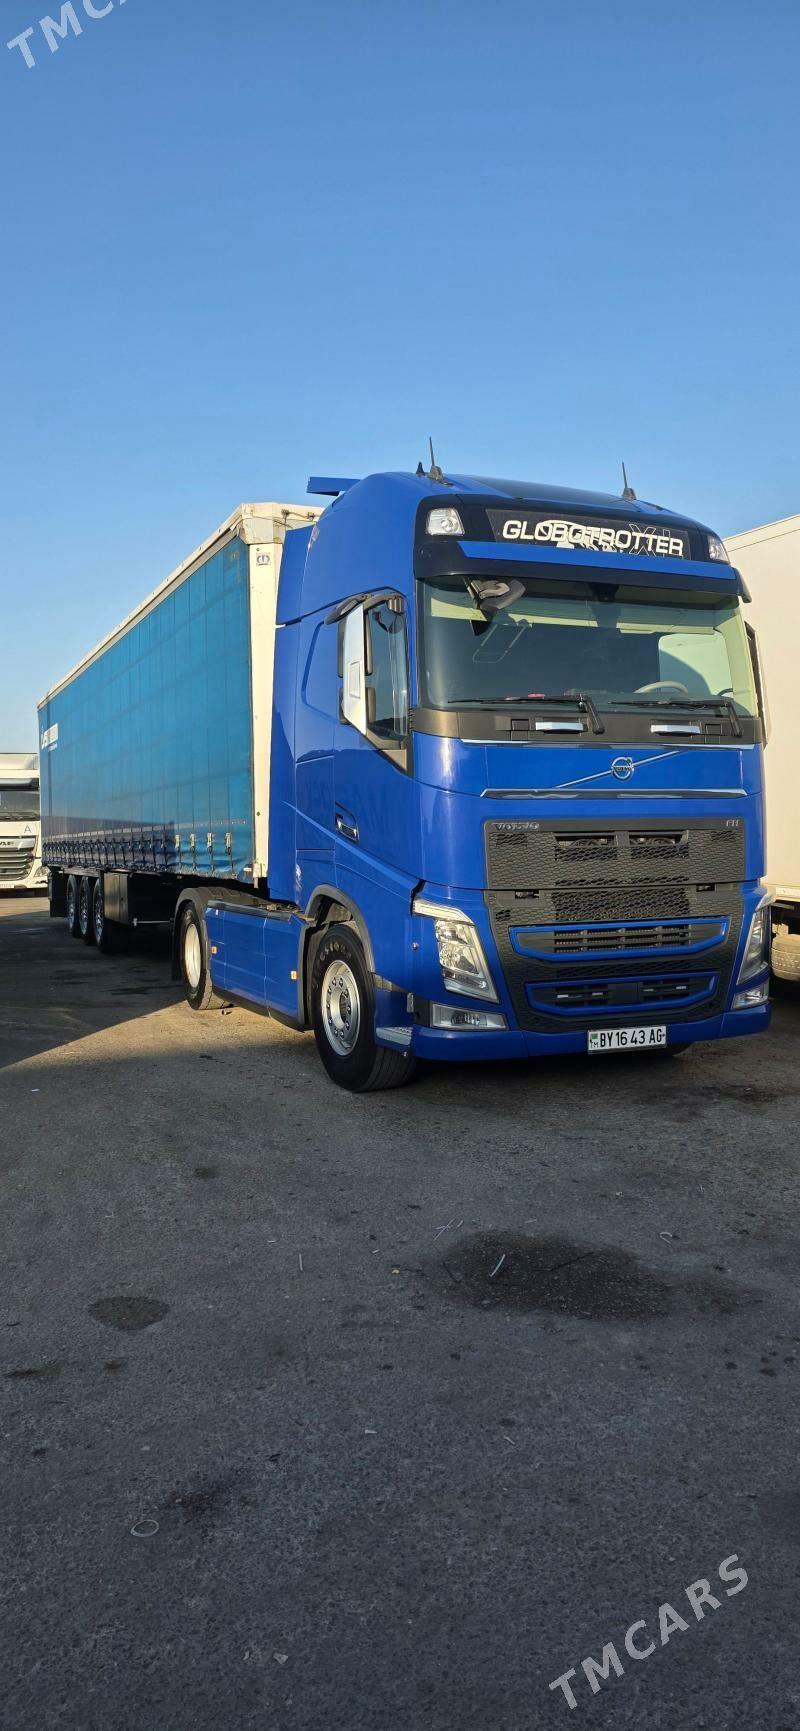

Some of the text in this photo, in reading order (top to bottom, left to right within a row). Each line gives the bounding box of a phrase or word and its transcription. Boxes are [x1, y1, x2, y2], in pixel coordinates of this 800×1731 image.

[502, 519, 684, 557] GLOBOTROTTER
[23, 824, 33, 835] A
[630, 1030, 646, 1045] 43
[649, 1029, 663, 1043] AG
